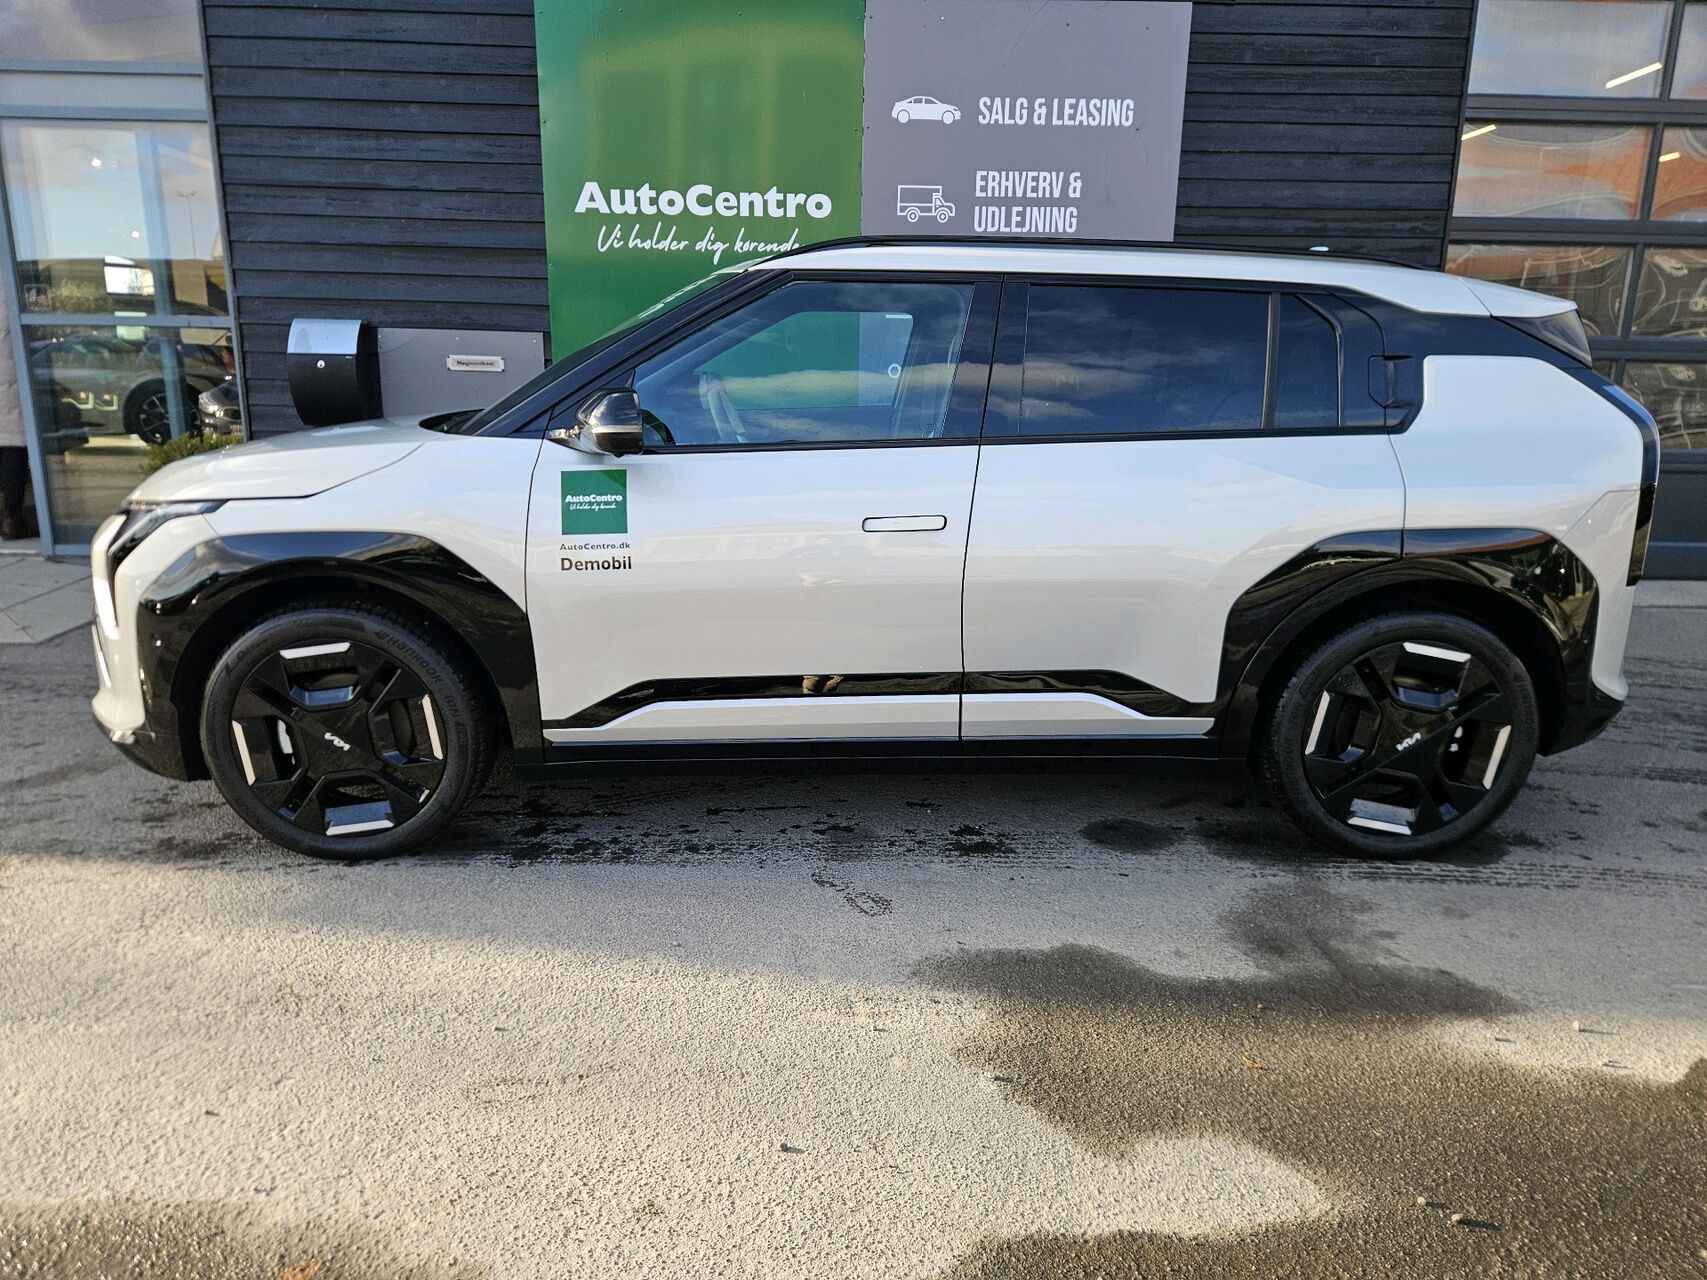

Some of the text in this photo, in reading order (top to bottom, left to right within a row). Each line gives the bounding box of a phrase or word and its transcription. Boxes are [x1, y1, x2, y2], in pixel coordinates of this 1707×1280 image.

[978, 96, 1135, 127] SALG & LEASING
[975, 170, 1083, 198] ERHVERV &
[574, 181, 832, 219] AutoCentro
[973, 206, 1078, 233] UDLEJNING
[597, 223, 623, 253] Vi
[628, 221, 690, 252] holder
[694, 226, 729, 265] dig
[565, 494, 622, 502] AutoCentro
[560, 542, 630, 551] AutoCentro.dk
[560, 556, 632, 571] Demobil
